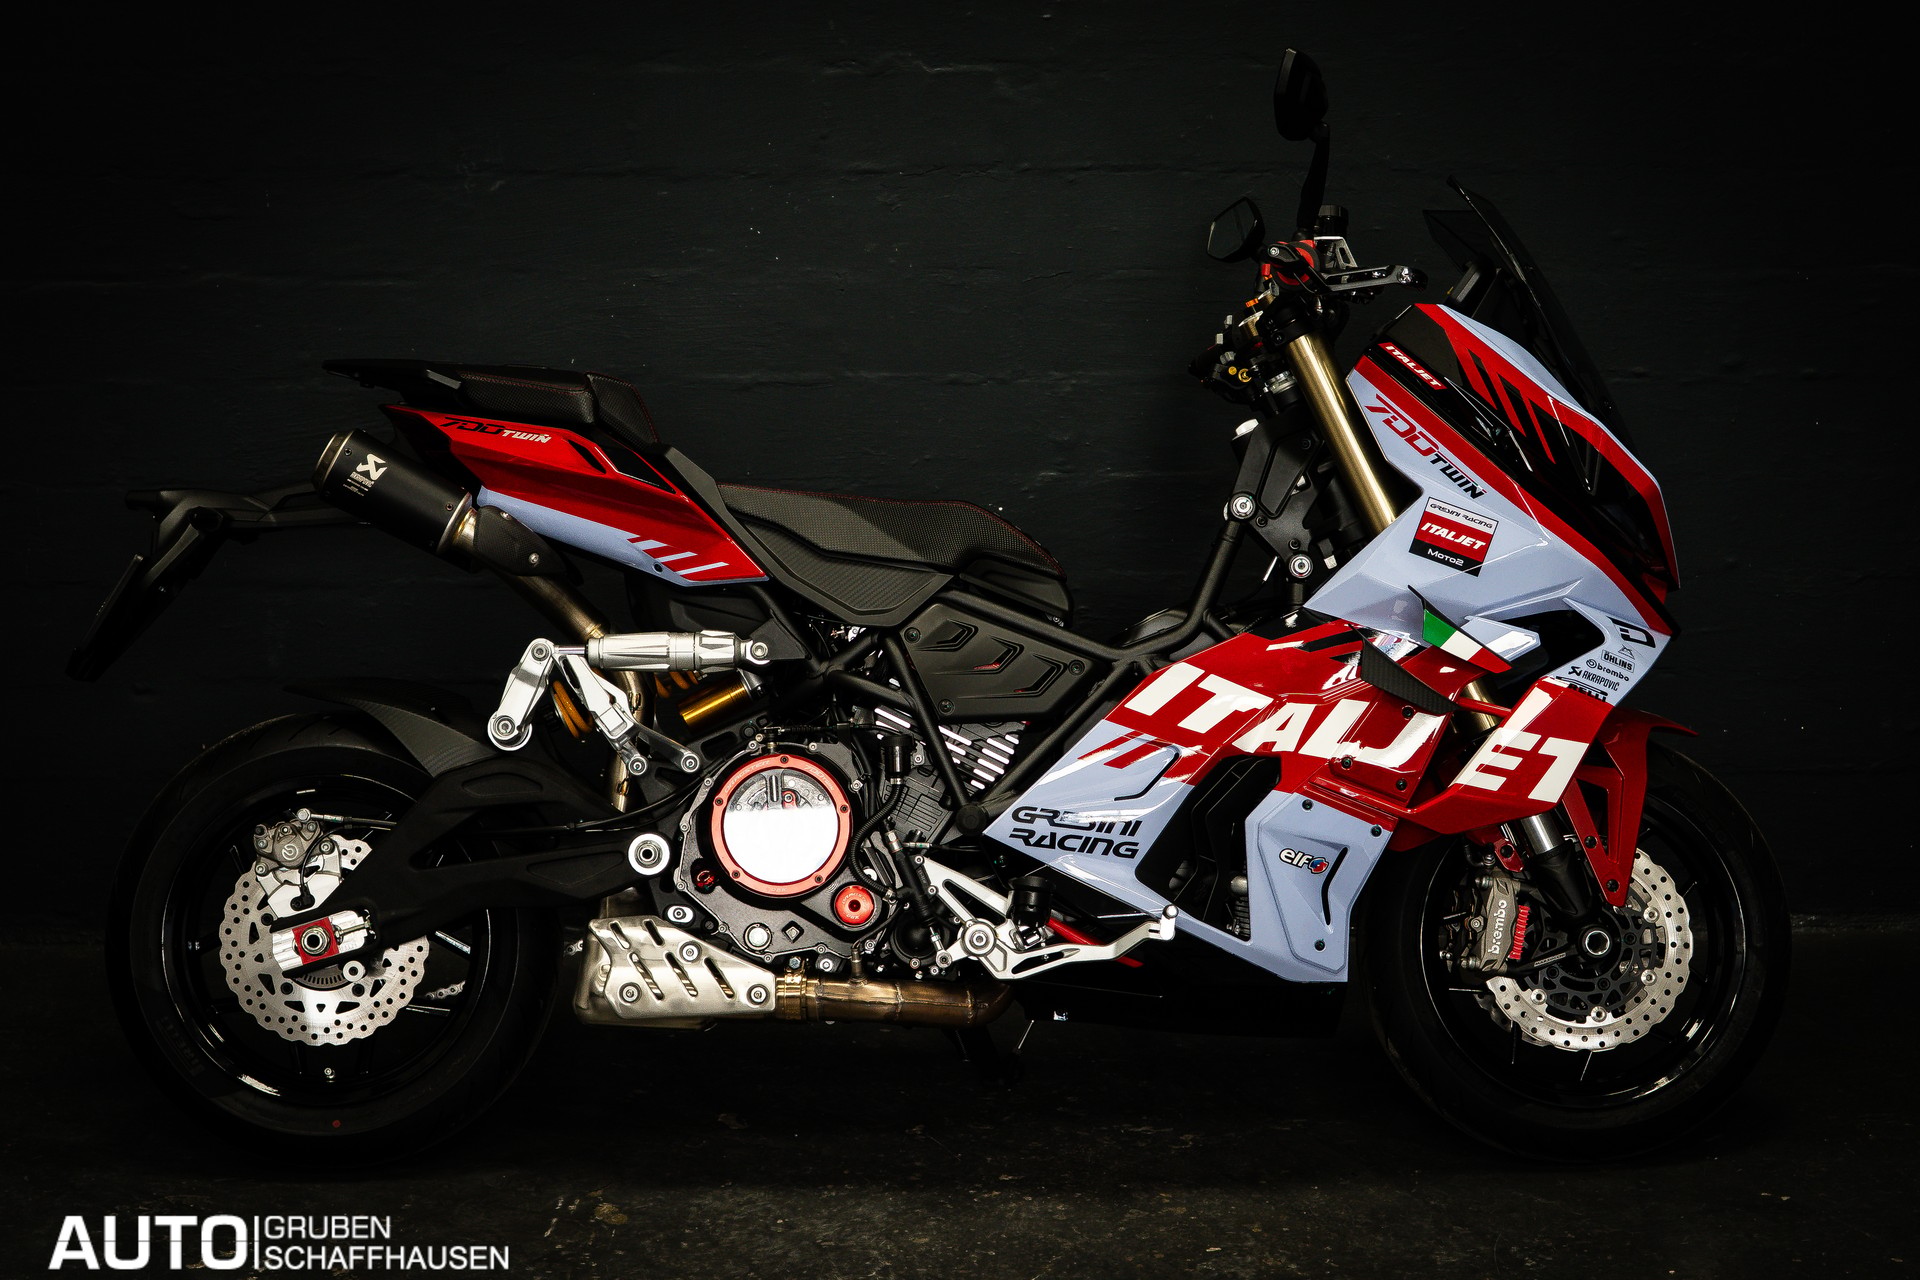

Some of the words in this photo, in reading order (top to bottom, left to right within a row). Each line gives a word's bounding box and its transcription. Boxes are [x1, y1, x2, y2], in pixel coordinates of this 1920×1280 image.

[1385, 345, 1442, 388] ITALJET
[1430, 503, 1461, 517] GRESINI
[1462, 515, 1493, 529] RACING
[1421, 522, 1486, 550] ITALJET
[1597, 663, 1630, 681] brembo
[1603, 651, 1634, 671] ÖHLINS
[1124, 661, 1590, 803] ITALJET
[1009, 827, 1140, 859] RACING
[1279, 848, 1314, 868] elf
[1488, 900, 1507, 954] brembo
